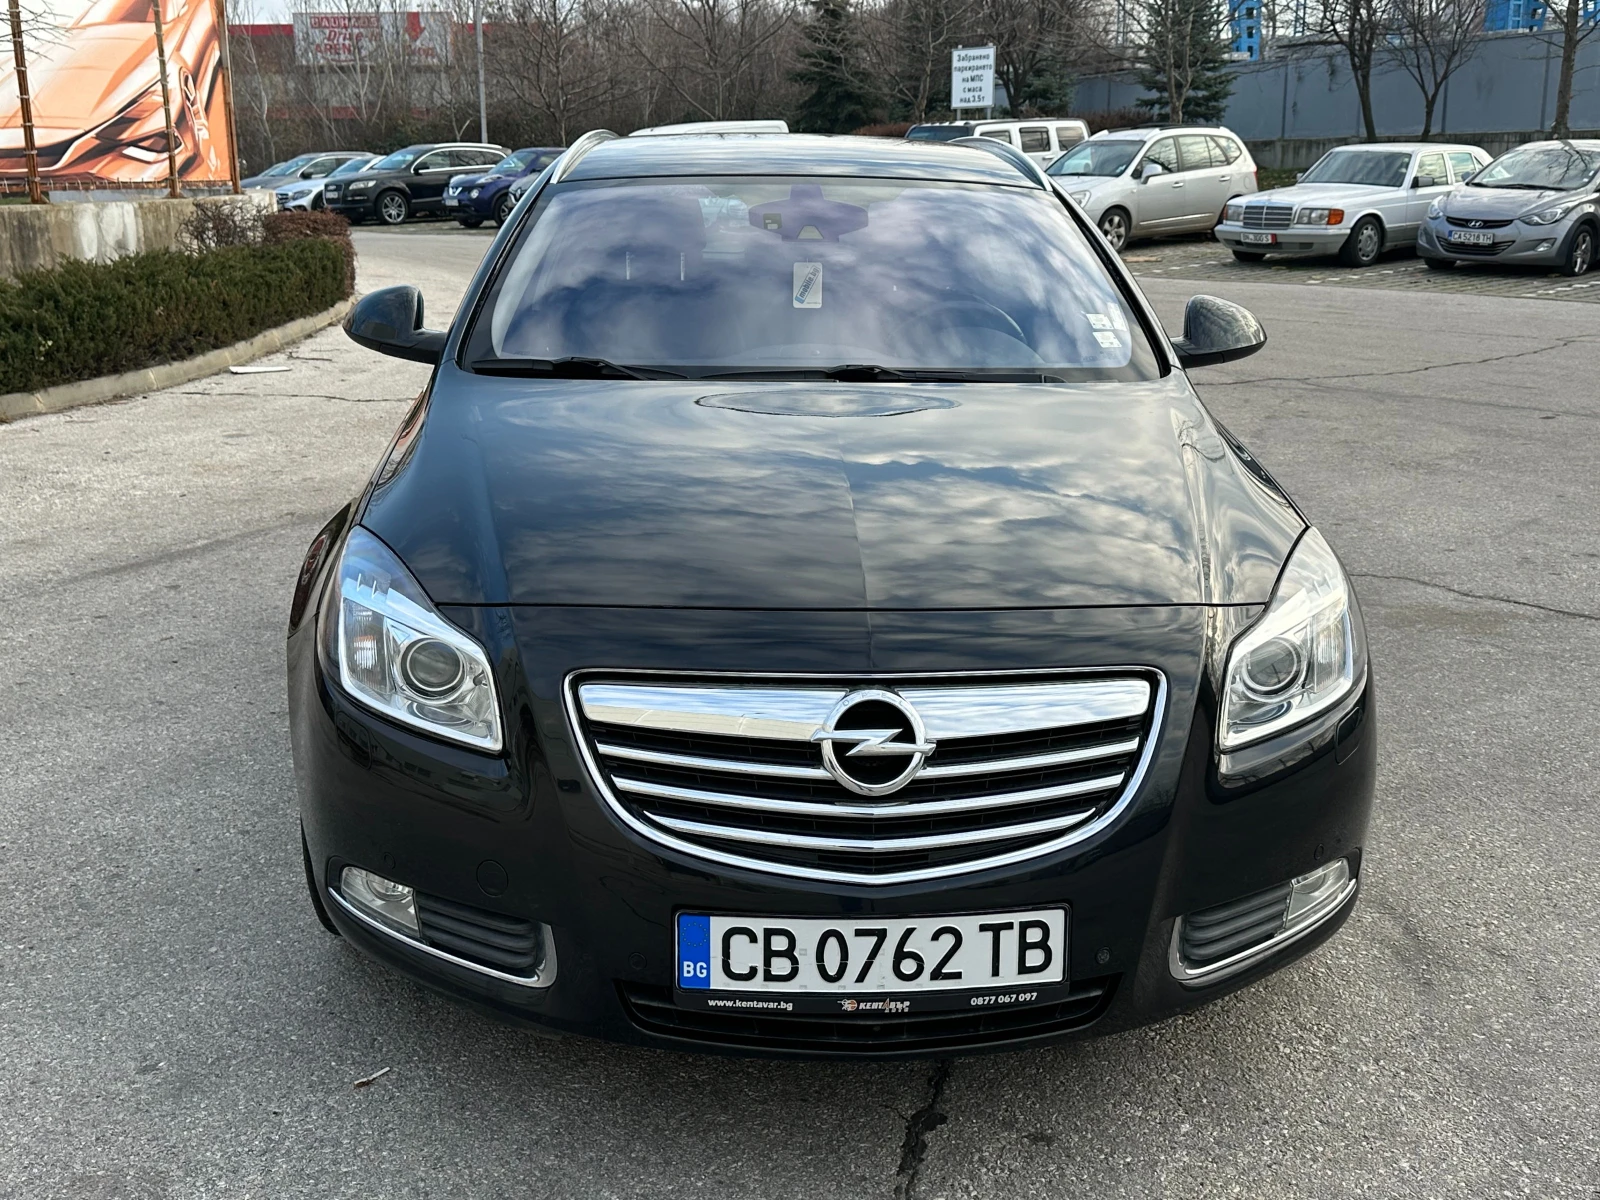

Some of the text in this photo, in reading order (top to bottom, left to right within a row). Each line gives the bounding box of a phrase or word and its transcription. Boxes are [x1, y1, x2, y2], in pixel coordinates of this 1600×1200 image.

[957, 53, 990, 63] Забранено
[953, 64, 993, 73] паркирането
[970, 74, 984, 82] МПС
[799, 267, 820, 298] mobile.bg
[721, 919, 1053, 984] CB 0762 TB
[682, 961, 707, 978] BG
[707, 999, 793, 1011] www.kentavar.bg
[970, 992, 1038, 1006] 0877 067 097
